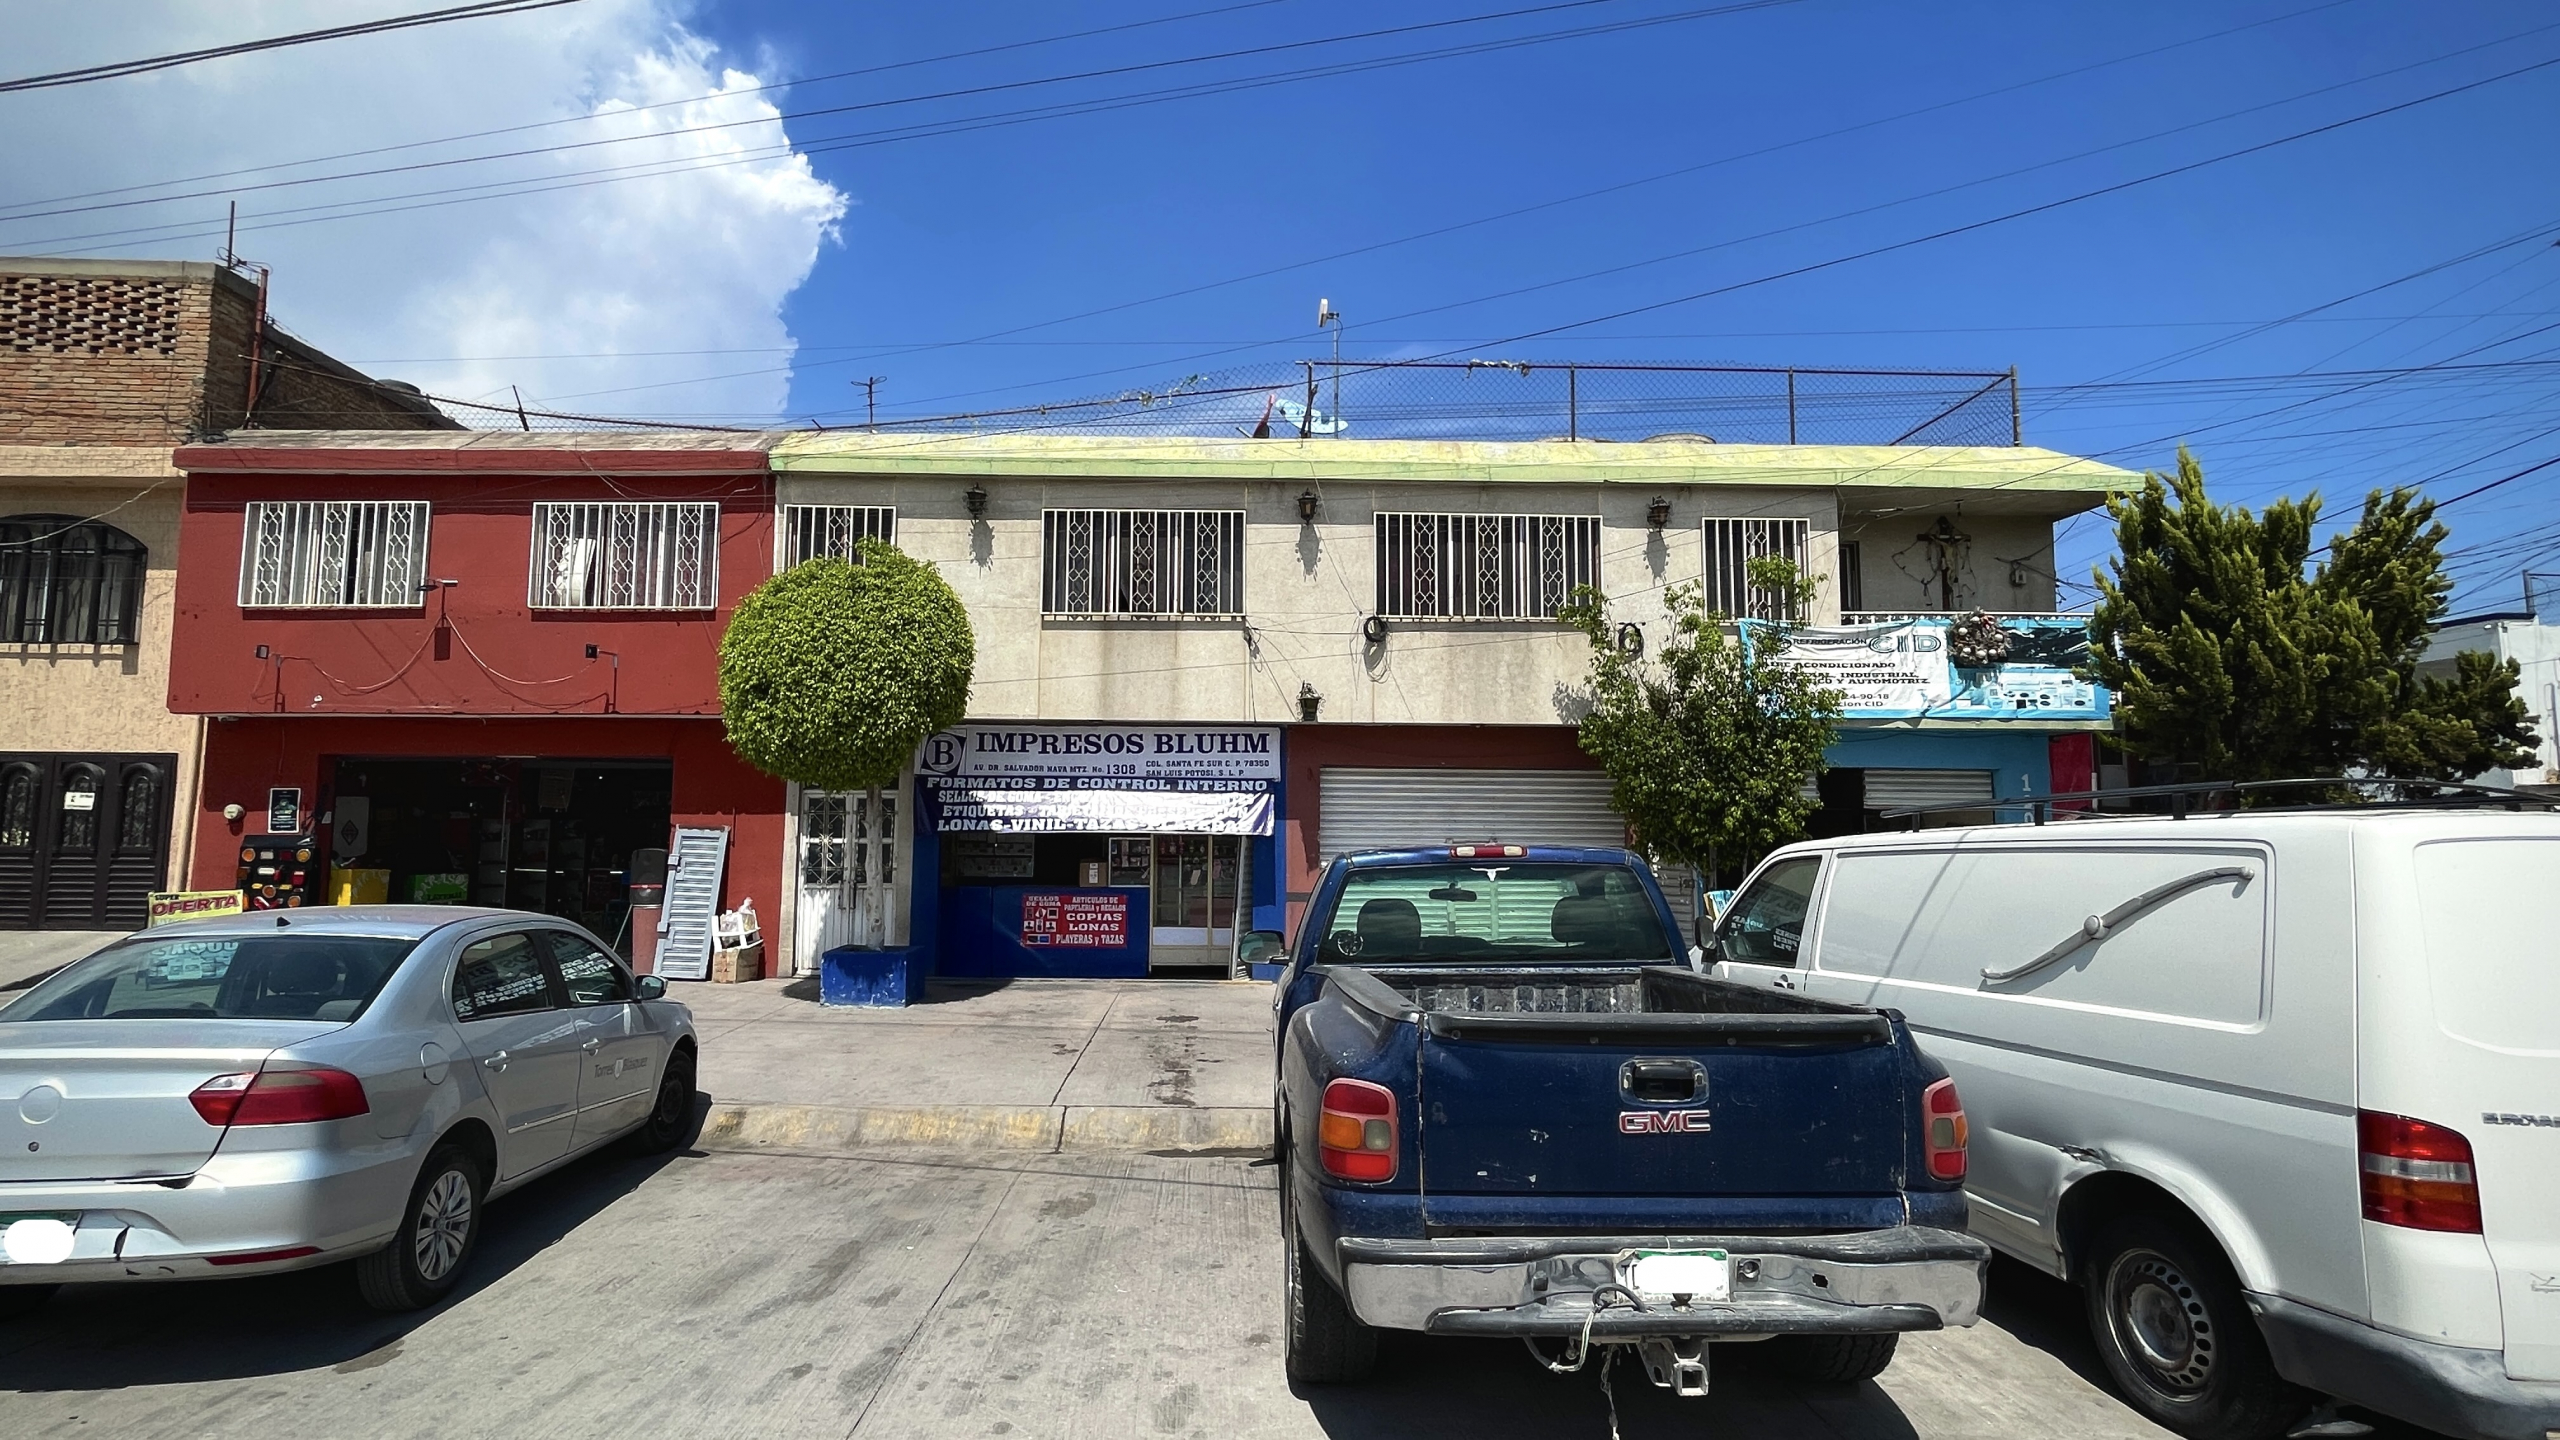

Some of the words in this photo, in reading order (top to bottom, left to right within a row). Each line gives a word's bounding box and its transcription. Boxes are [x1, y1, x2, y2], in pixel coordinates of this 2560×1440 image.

[1868, 634, 1942, 654] CID
[975, 731, 1145, 755] IMPRESOS
[1153, 732, 1270, 754] BLUHM
[1004, 764, 1045, 773] SALVADOR
[1046, 765, 1068, 773] NAVA
[1106, 764, 1137, 775] 1308
[1166, 760, 1191, 768] SANTA
[1194, 760, 1204, 768] FE
[1206, 760, 1223, 768] SUR
[1145, 769, 1162, 777] SAN
[1164, 769, 1183, 777] LUIS
[926, 776, 1037, 789] FORMATOS
[1043, 777, 1071, 789] DE
[1076, 778, 1171, 791] CONTROL
[1177, 779, 1268, 791] INTERNO
[151, 894, 240, 917] OFERTA
[1109, 896, 1118, 904] DE
[1066, 912, 1123, 921] COPIAS
[1068, 922, 1120, 931] LONAS
[1056, 934, 1093, 945] PLAYERAS
[1101, 934, 1124, 945] TAZAS
[1618, 1109, 1711, 1134] GMC
